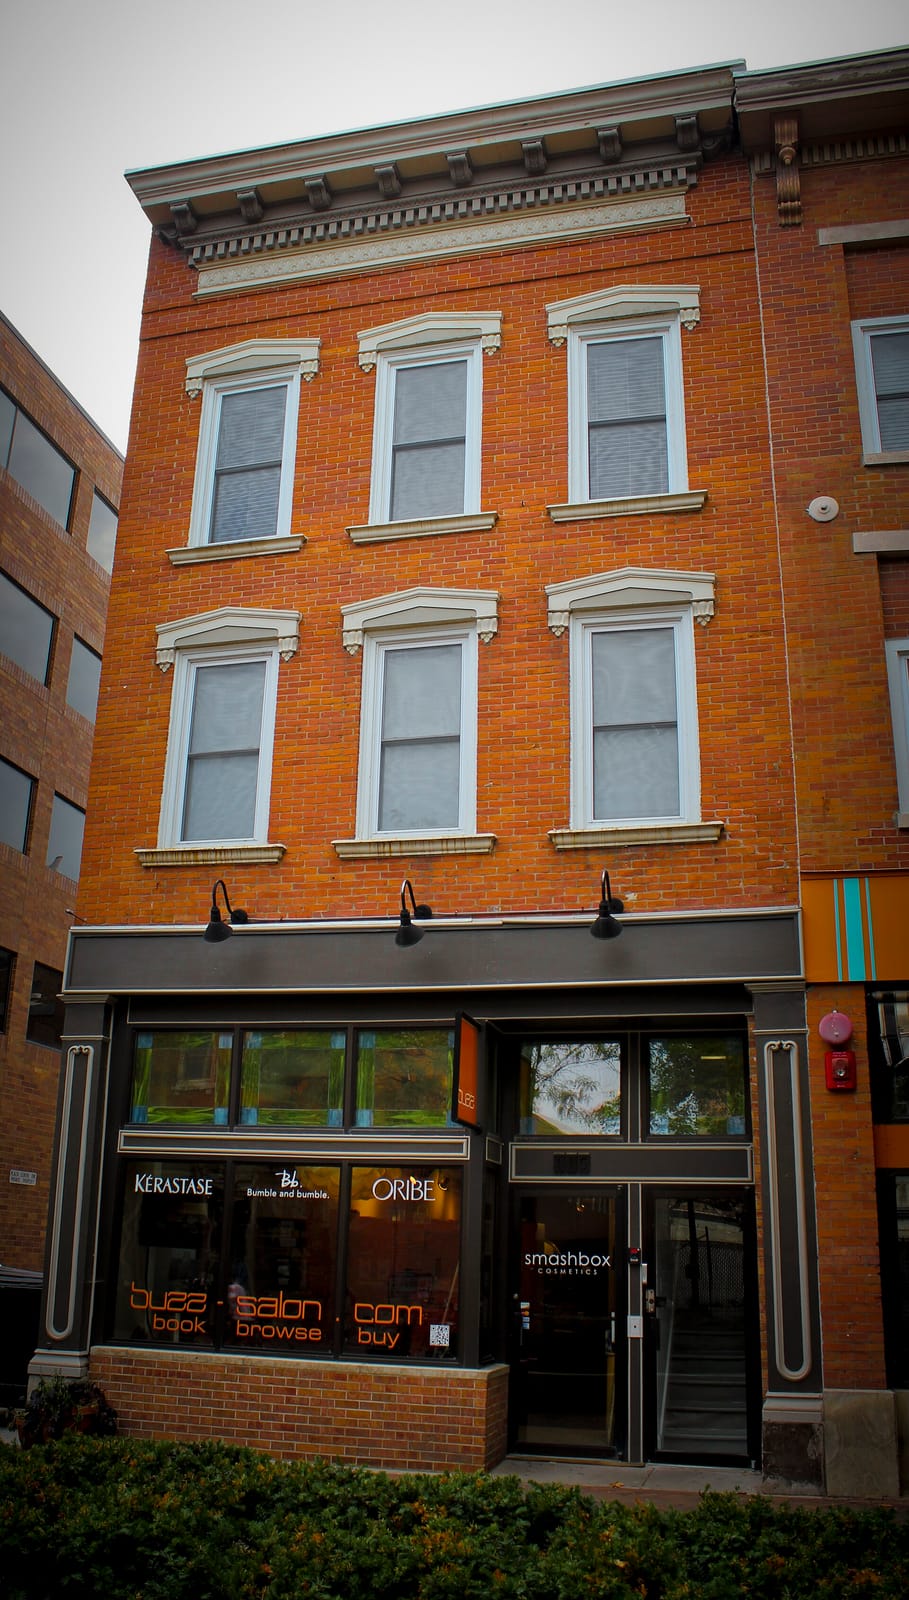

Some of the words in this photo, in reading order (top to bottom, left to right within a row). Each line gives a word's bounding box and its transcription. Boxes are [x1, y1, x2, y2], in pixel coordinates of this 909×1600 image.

[134, 1173, 213, 1196] KÉRASTASE
[247, 1188, 277, 1198] Bumble
[279, 1189, 295, 1198] and
[296, 1189, 330, 1199] bumble.
[372, 1178, 436, 1201] ORIBE
[524, 1251, 611, 1267] smashbox
[537, 1268, 598, 1276] COSMETICS
[130, 1281, 207, 1313] buzz
[236, 1290, 322, 1321] salon
[354, 1303, 423, 1326] com
[153, 1313, 206, 1334] book
[236, 1319, 322, 1342] browse
[357, 1327, 400, 1349] buy
